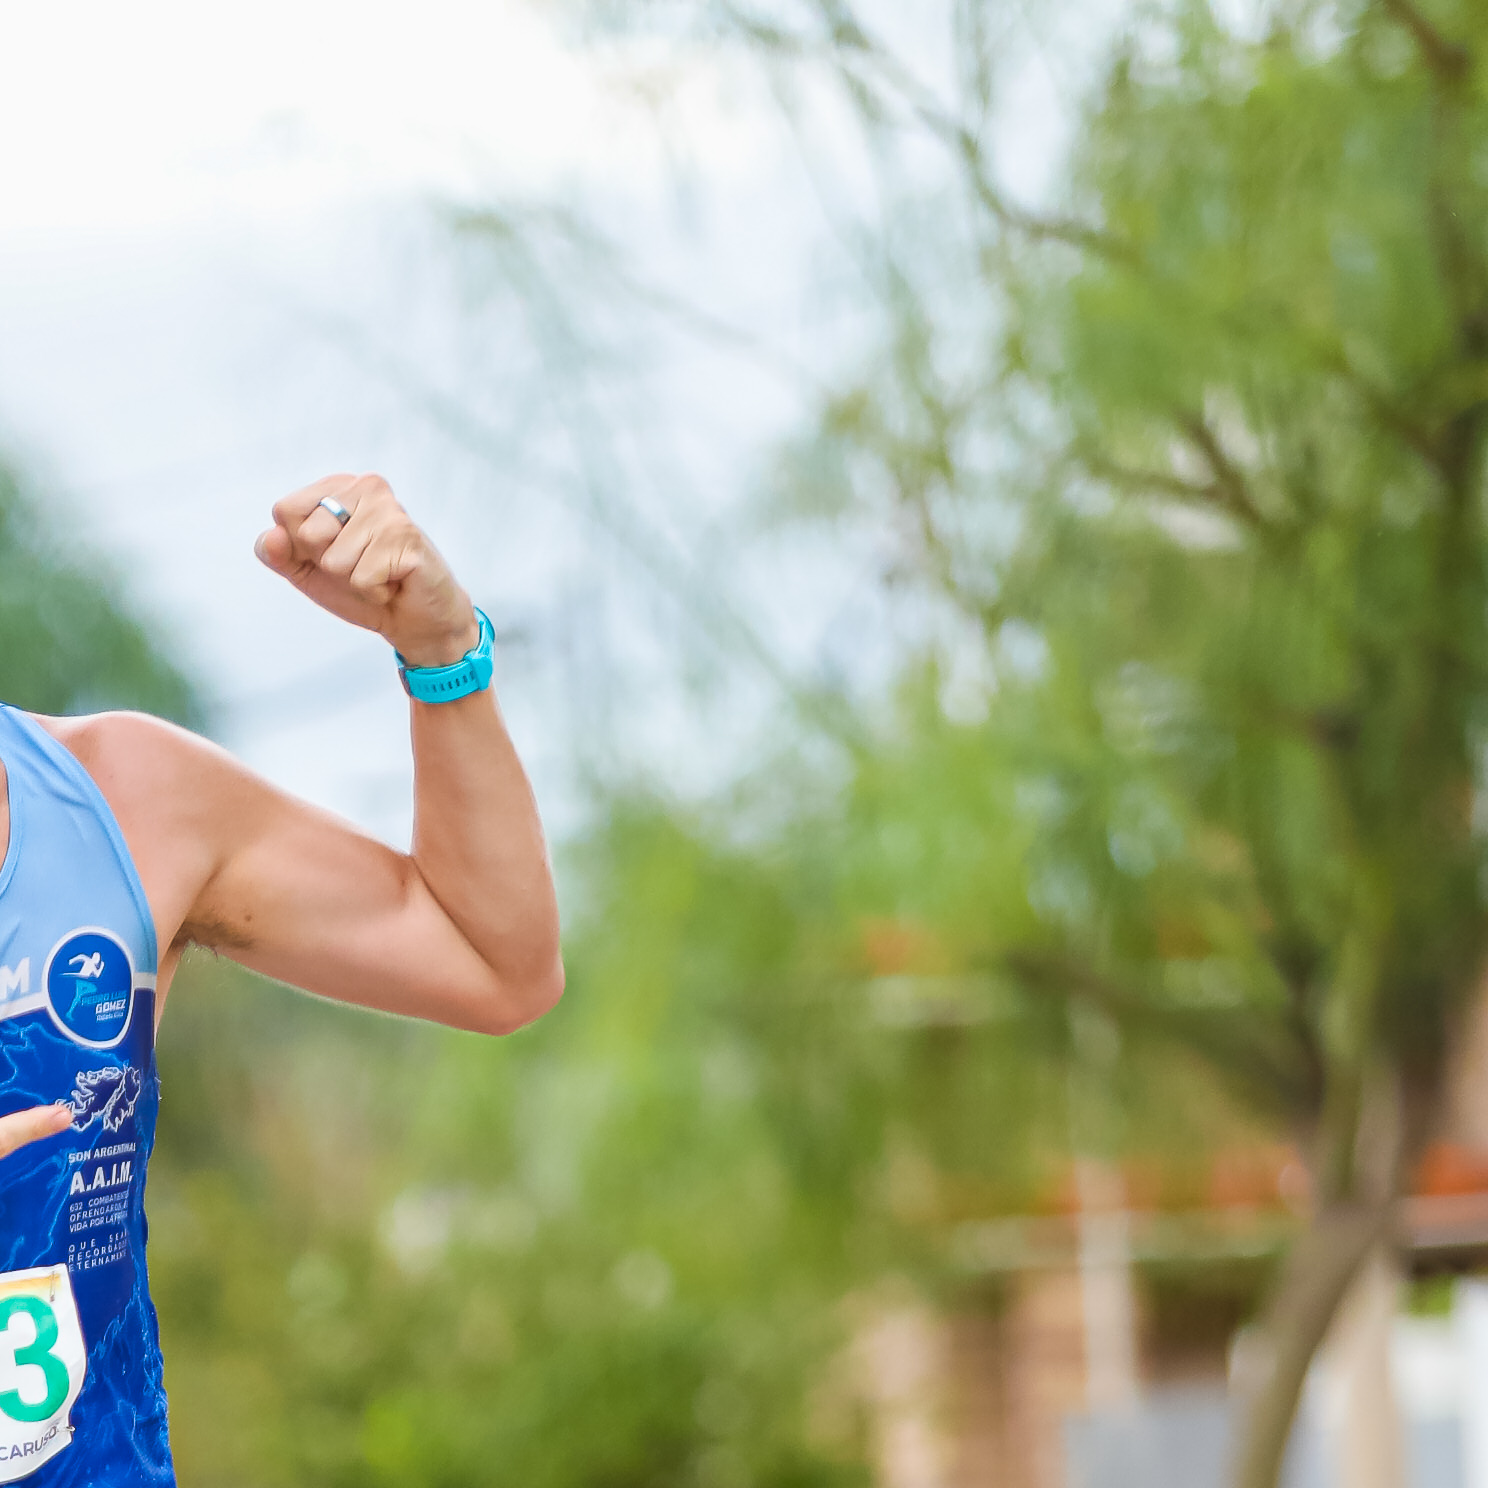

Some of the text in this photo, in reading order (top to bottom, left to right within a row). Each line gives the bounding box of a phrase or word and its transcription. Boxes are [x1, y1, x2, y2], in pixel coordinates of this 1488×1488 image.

[68, 1149, 91, 1164] SON
[70, 1160, 134, 1196] A.A.I.M.
[69, 1221, 88, 1233] VIDA
[89, 1215, 105, 1228] POR
[68, 1238, 96, 1254] QUE
